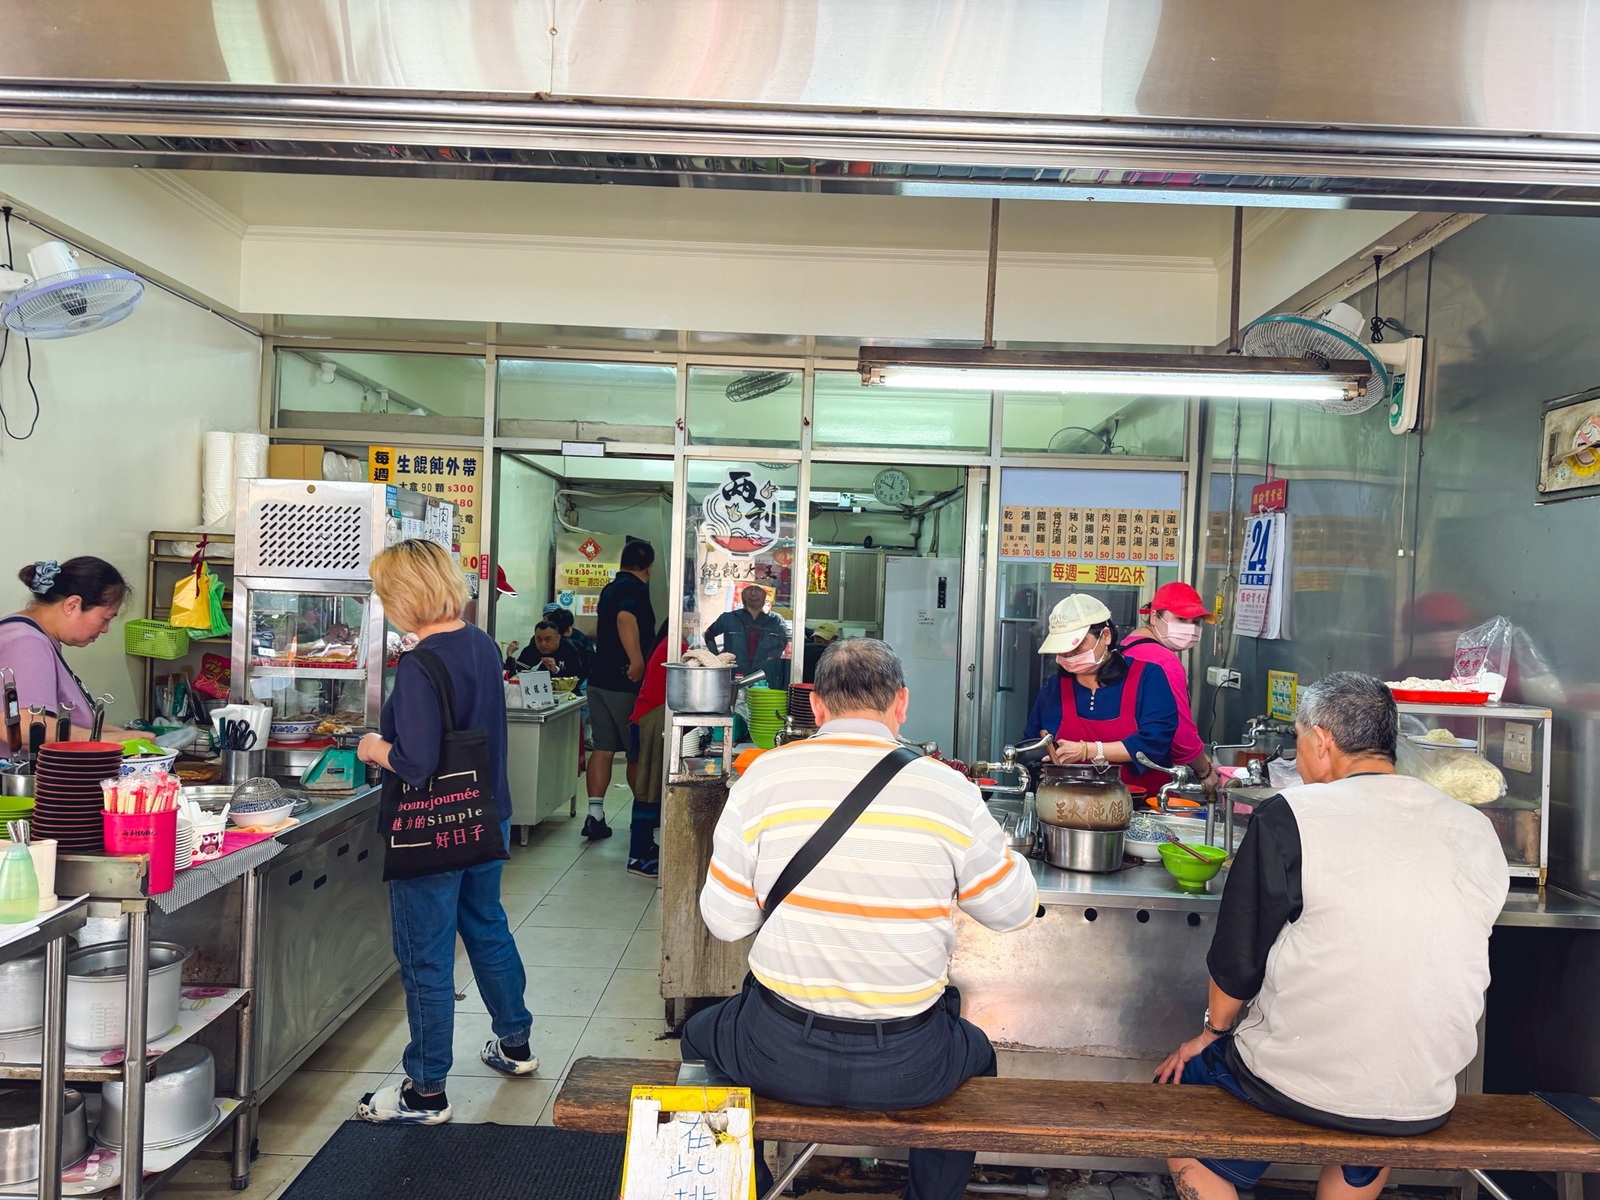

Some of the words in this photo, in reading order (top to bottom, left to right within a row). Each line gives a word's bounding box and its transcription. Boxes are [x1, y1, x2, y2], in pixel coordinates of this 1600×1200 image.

[374, 451, 390, 481] 每週
[397, 454, 477, 477] 生餛飩外帶
[1052, 512, 1062, 544] 骨仔肉湯
[1068, 512, 1078, 544] 豬心湯
[1100, 513, 1110, 545] 肉片湯
[1133, 513, 1143, 546] 魚丸湯
[1149, 514, 1159, 547] 貢丸湯
[1001, 548, 1009, 556] 35
[1247, 518, 1272, 571] 24
[700, 562, 777, 580] 餛飩大王
[1053, 563, 1089, 581] 每週一
[1095, 565, 1145, 584] 週四公休
[435, 824, 485, 849] 好日子
